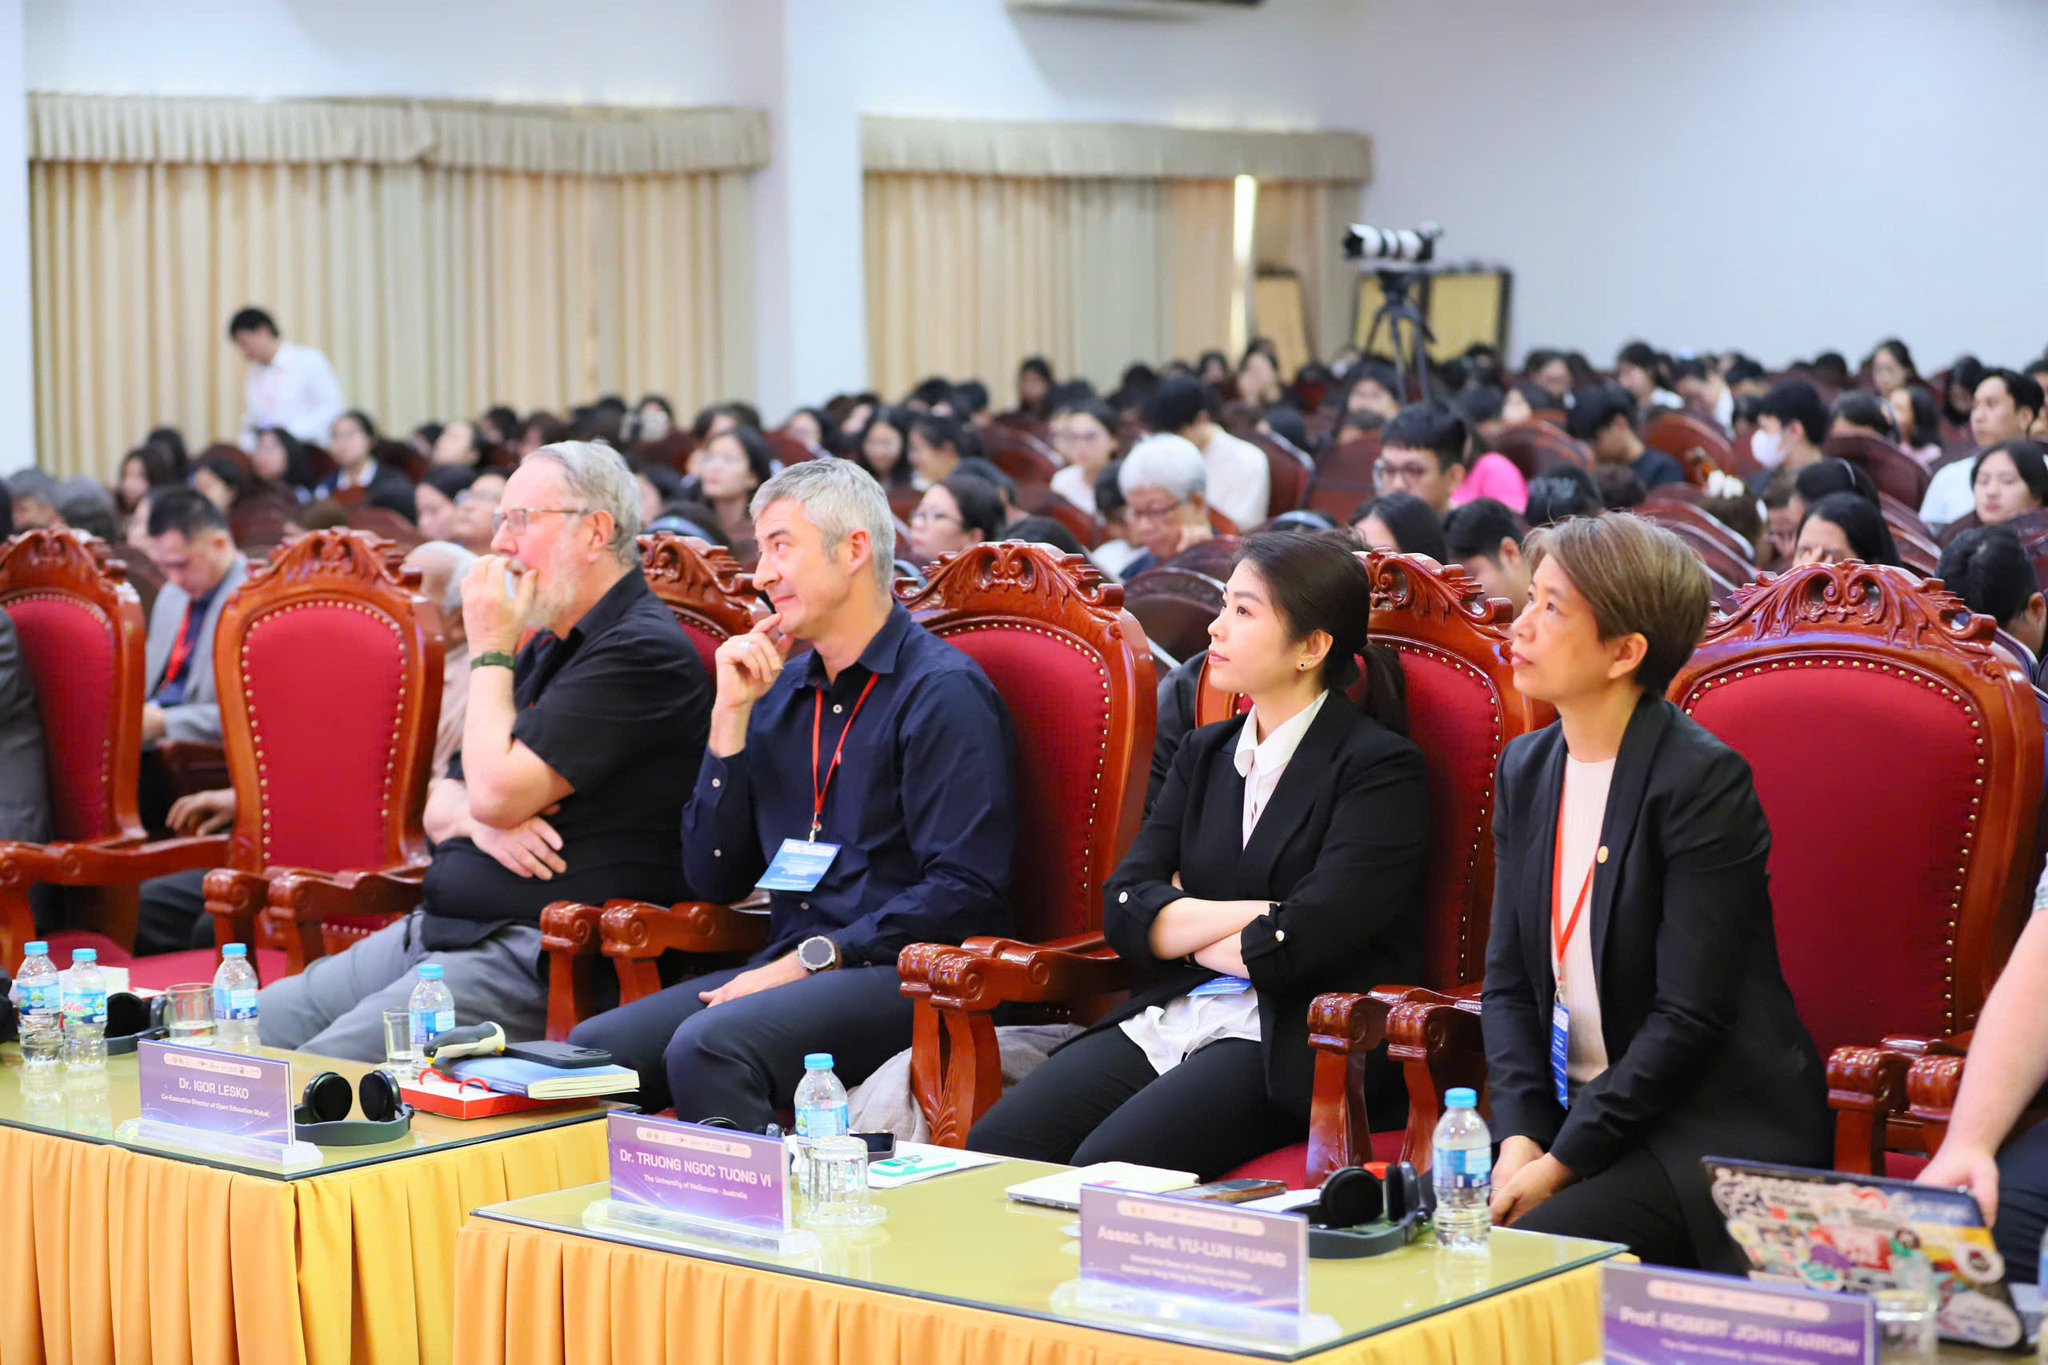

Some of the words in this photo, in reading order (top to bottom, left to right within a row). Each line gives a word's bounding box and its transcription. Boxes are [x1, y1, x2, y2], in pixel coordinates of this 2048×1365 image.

[179, 1078, 192, 1090] Dr.
[193, 1080, 216, 1095] IGOR
[218, 1085, 249, 1099] LESKO
[620, 1149, 634, 1163] Dr.
[636, 1151, 682, 1171] TRUONG
[684, 1161, 716, 1178] NGOC
[718, 1166, 758, 1184] TUONG
[760, 1173, 772, 1188] VI
[644, 1174, 654, 1182] The
[655, 1176, 683, 1189] University
[683, 1181, 690, 1189] of
[1144, 1231, 1176, 1251] Prof.
